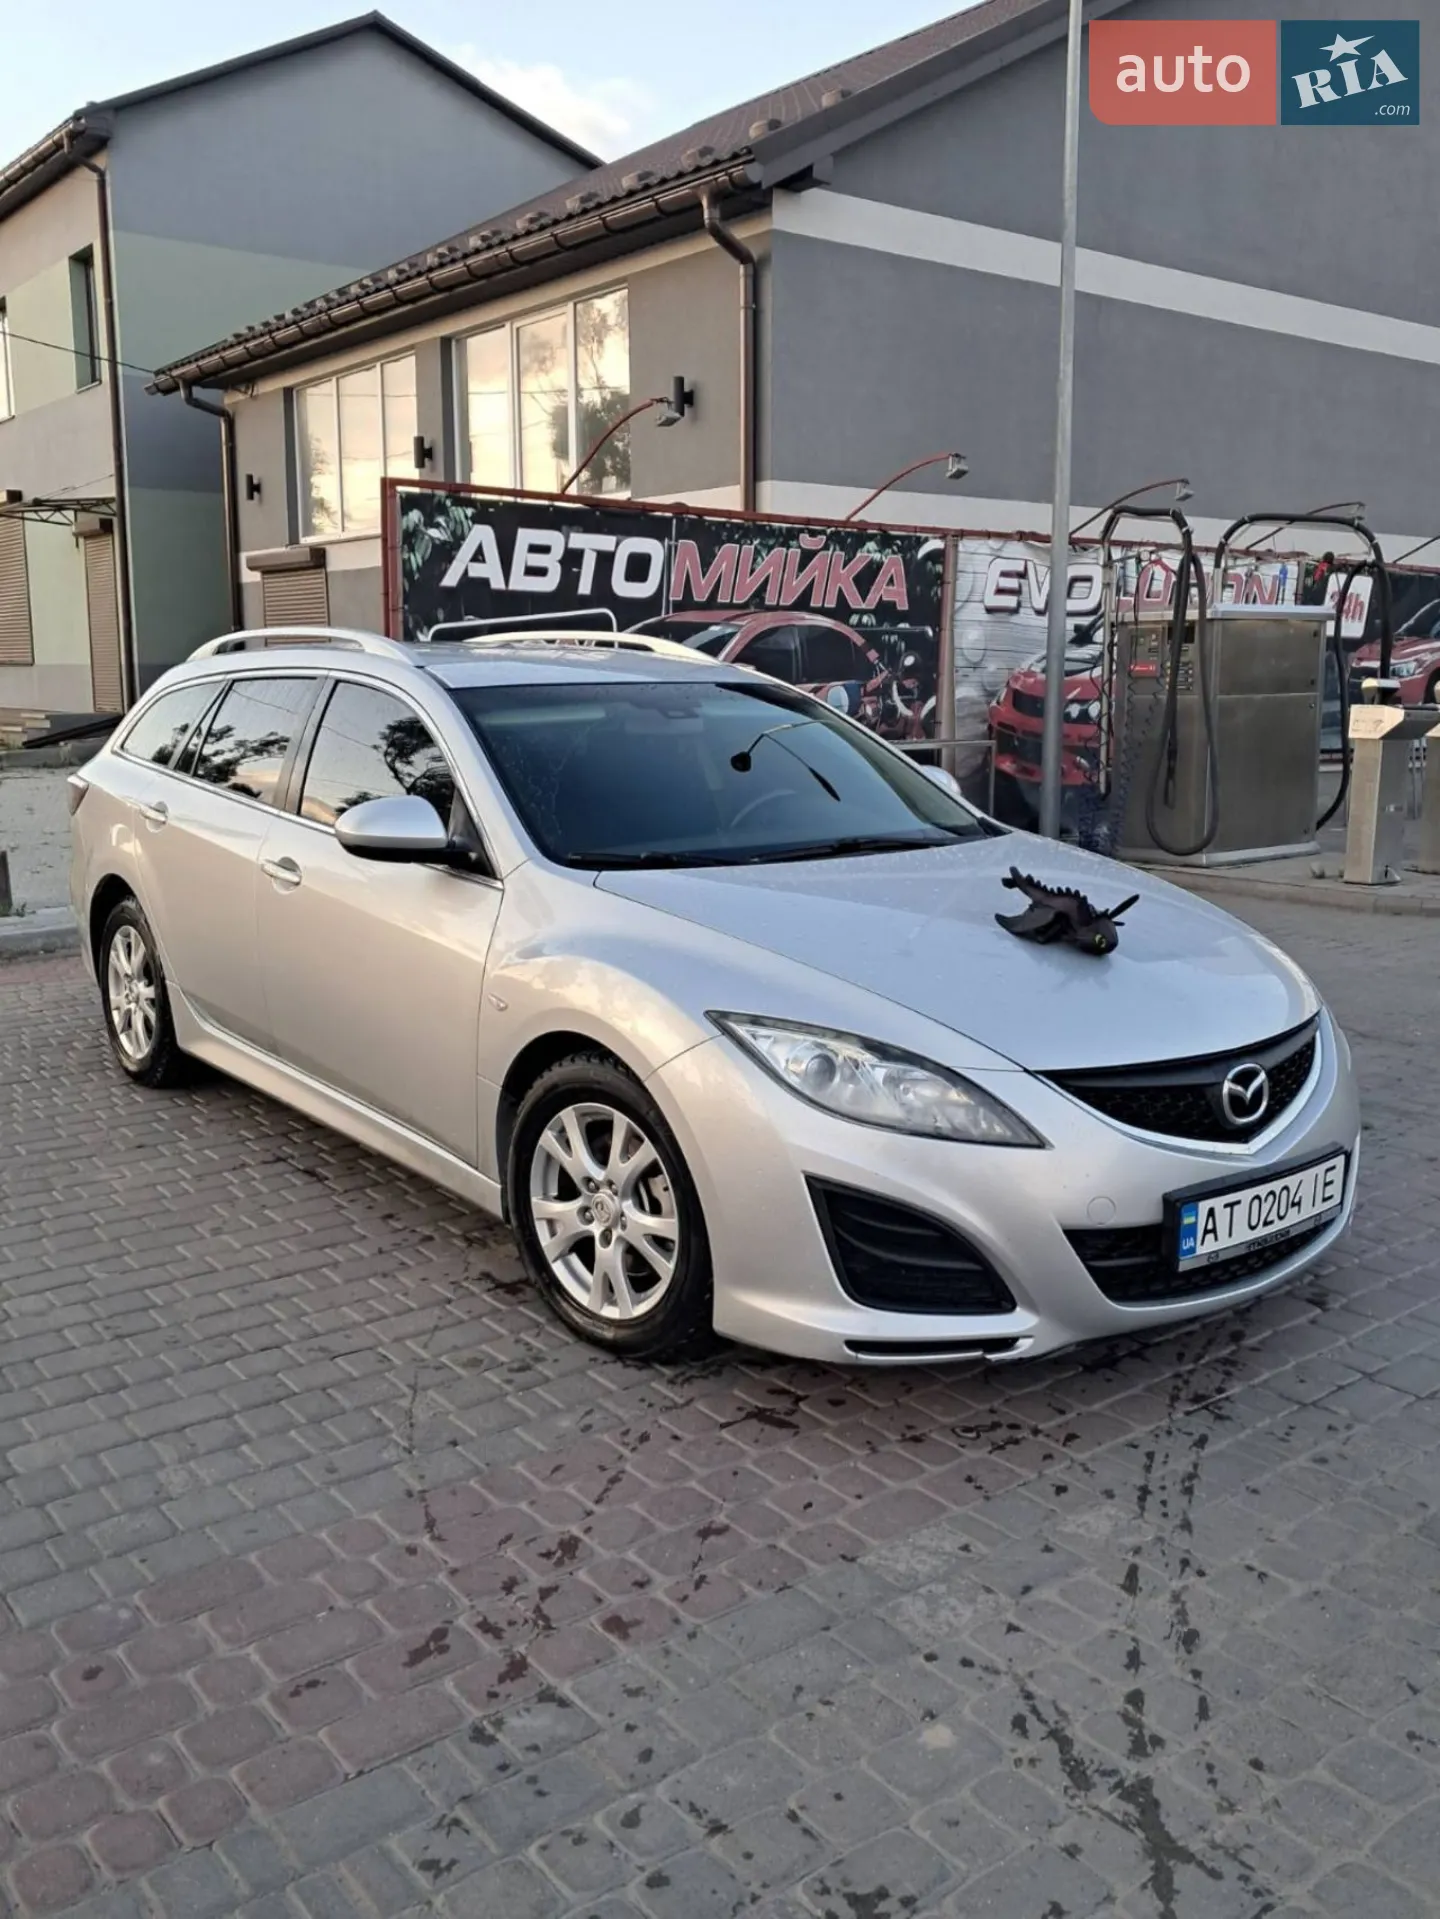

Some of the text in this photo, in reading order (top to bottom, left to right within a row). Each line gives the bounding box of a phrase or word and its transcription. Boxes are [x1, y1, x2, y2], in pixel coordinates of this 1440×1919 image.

[439, 523, 909, 611] АВТОМИЙКА
[1182, 1236, 1195, 1251] UA
[1200, 1199, 1242, 1246] AT
[1247, 1179, 1303, 1231] 0204
[1311, 1164, 1337, 1207] IE
